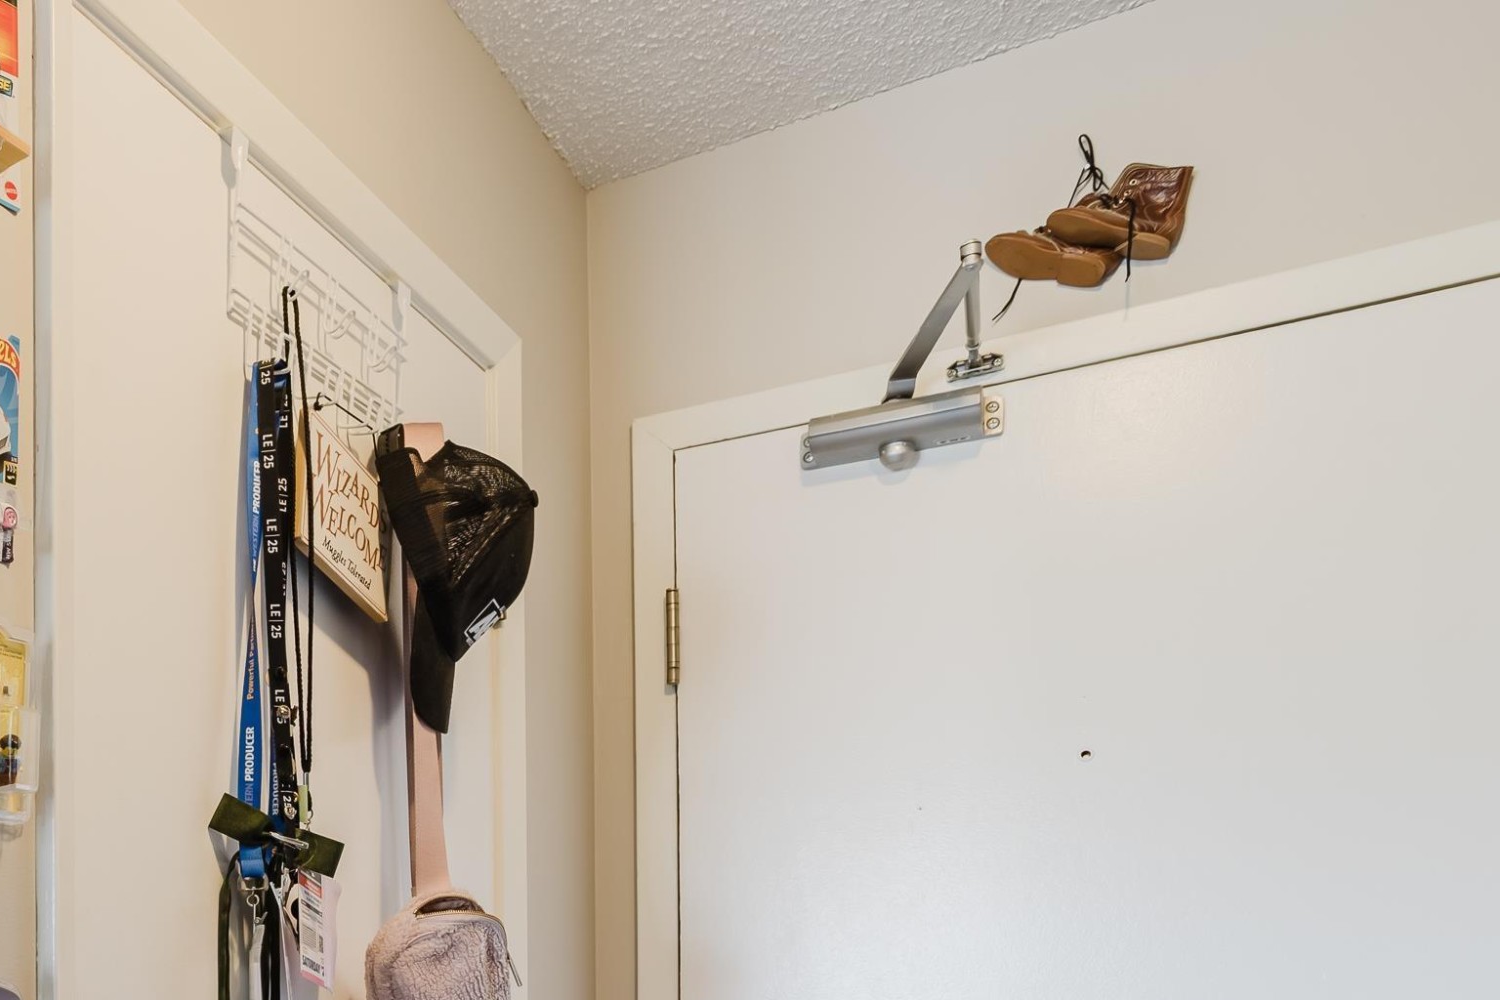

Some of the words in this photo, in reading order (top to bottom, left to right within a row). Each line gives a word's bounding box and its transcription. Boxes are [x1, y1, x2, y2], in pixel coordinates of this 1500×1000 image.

[316, 430, 387, 534] WIZARDS
[322, 536, 347, 566] Muggles
[348, 558, 373, 590] Tolerated
[244, 726, 254, 782] PRODUCER
